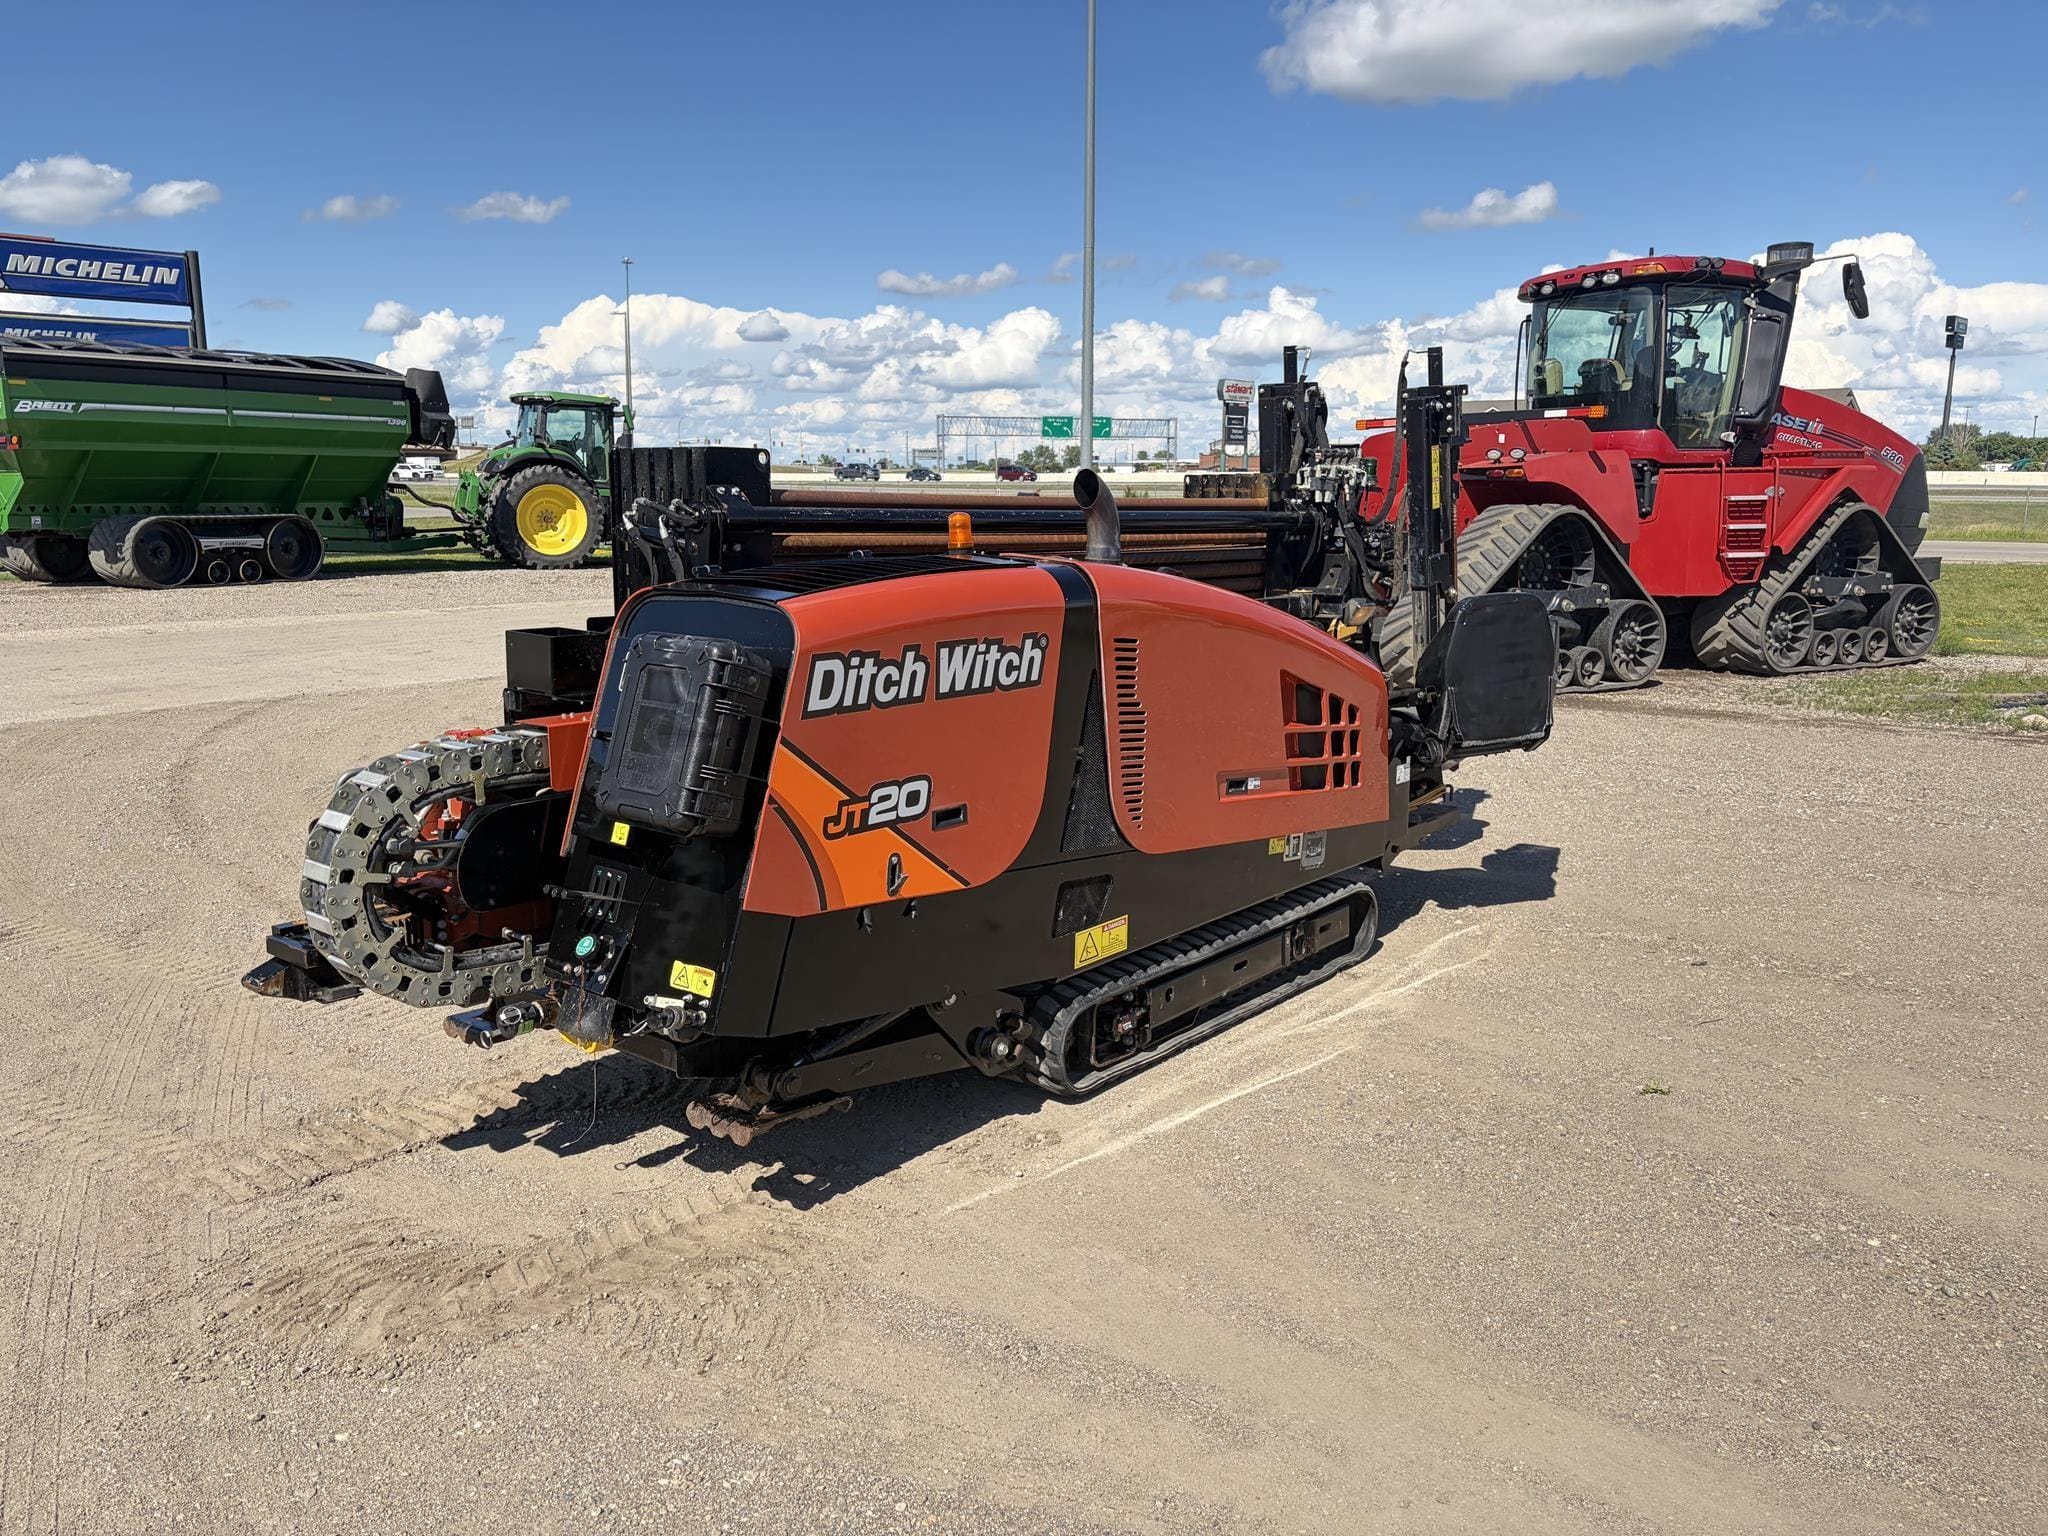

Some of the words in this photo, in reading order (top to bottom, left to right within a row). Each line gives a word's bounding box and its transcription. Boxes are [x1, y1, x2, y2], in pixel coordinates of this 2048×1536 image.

[6, 253, 180, 286] MICHELIN
[1769, 411, 1809, 431] ASE
[1776, 432, 1823, 449] QUADTRAC
[1880, 445, 1905, 465] 580
[806, 650, 928, 712] Ditch
[827, 779, 929, 834] JT20
